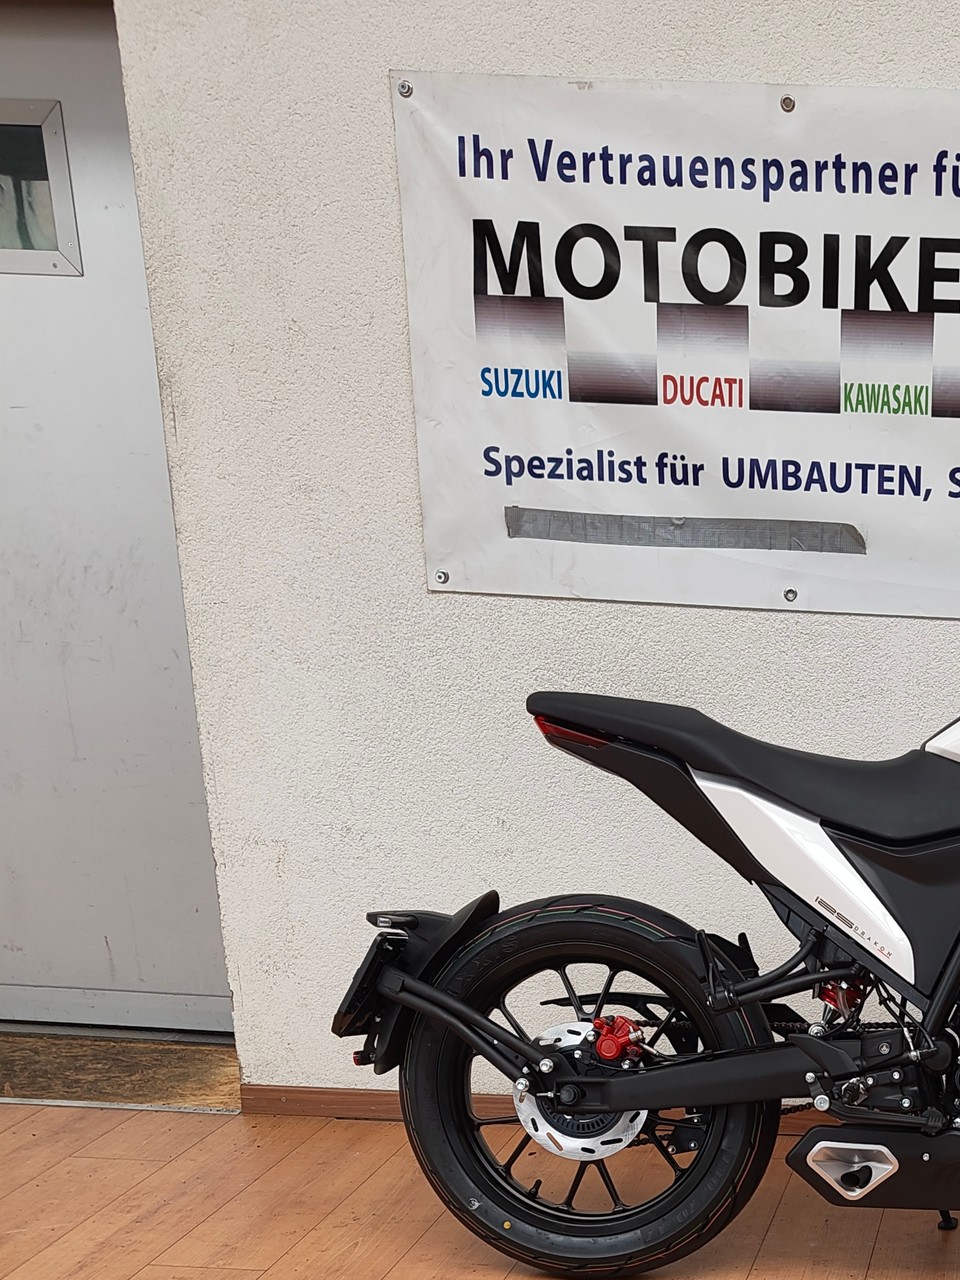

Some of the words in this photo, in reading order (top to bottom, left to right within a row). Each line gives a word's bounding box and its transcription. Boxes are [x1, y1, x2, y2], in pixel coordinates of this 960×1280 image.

[458, 134, 513, 180] Ihr
[527, 138, 919, 202] Vertrauenspartner
[480, 367, 563, 399] SUZUKI
[662, 375, 743, 408] DUCATI
[843, 383, 930, 416] KAWASAKI
[483, 446, 647, 485] Spezialist
[655, 452, 704, 486] für
[722, 457, 933, 502] UMBAUTEN,
[854, 925, 892, 957] DRAKON
